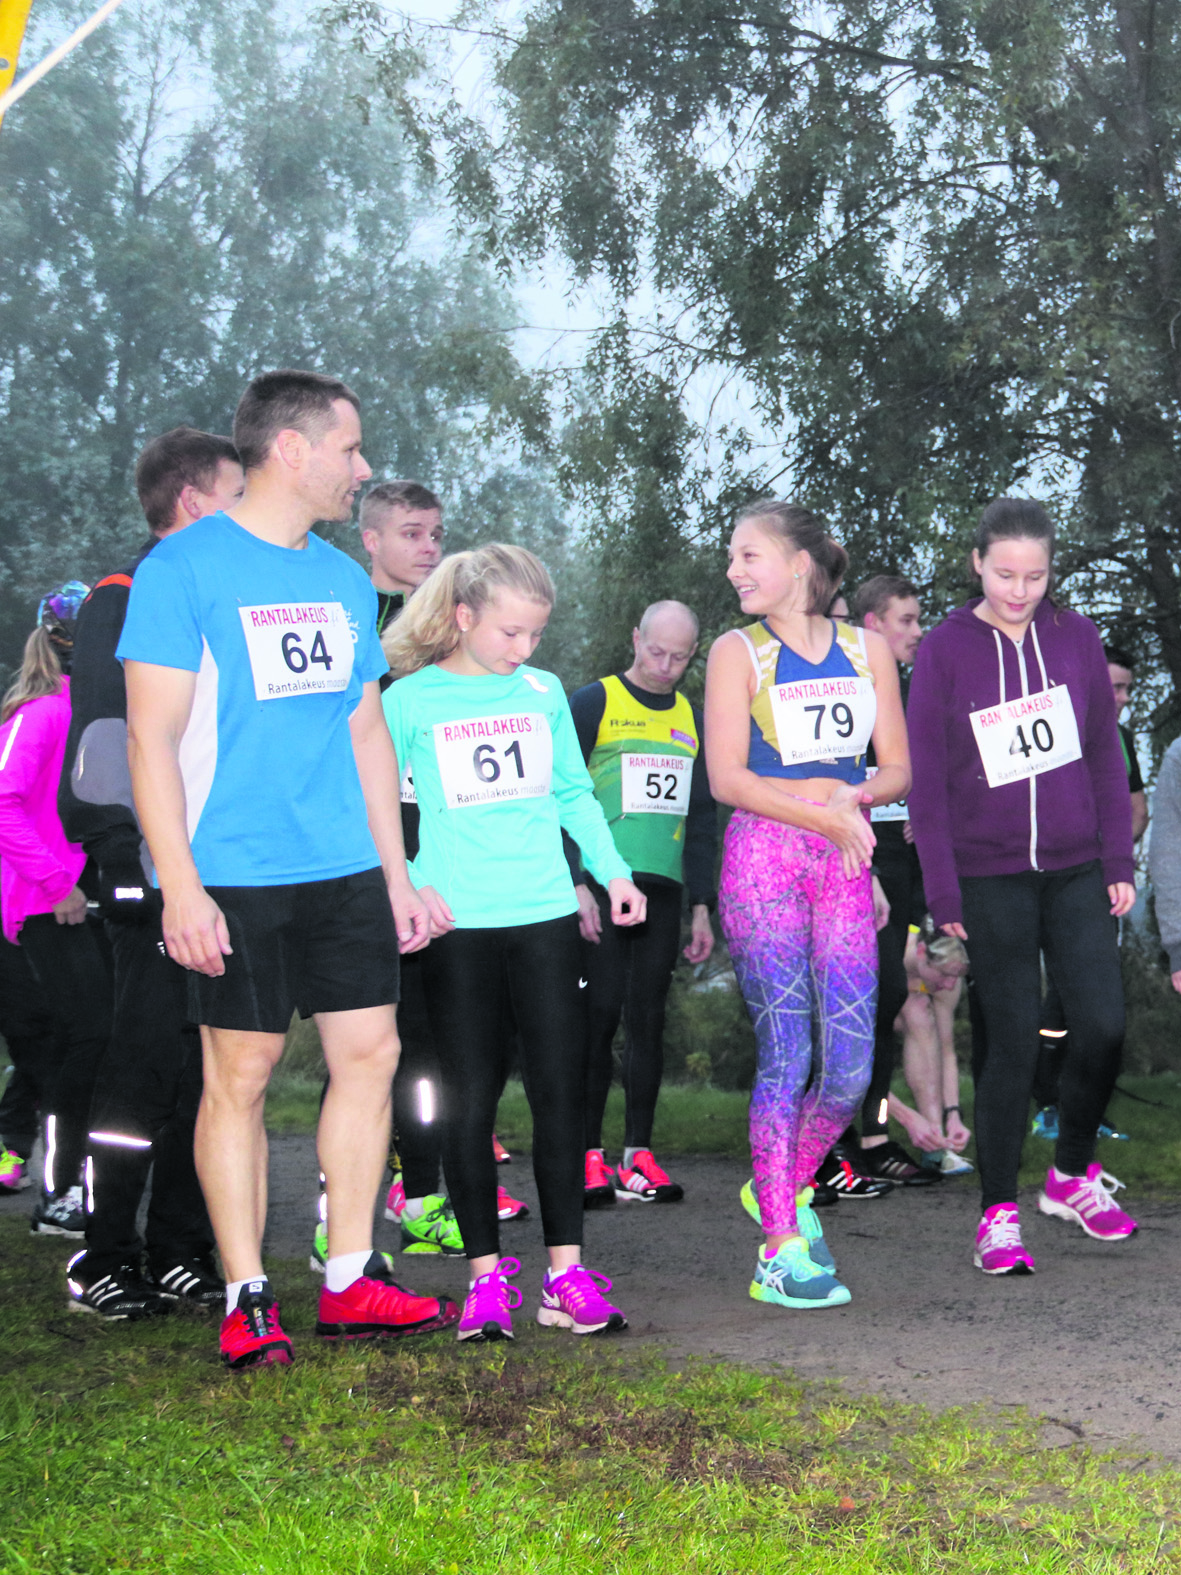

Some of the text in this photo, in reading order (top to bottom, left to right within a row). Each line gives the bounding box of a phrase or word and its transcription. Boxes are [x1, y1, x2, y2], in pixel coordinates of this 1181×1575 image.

[250, 607, 329, 627] RANTALAKEUS
[281, 630, 333, 674] 64
[268, 679, 326, 694] Rantalakeus
[779, 681, 857, 702] RANTALAKEUS
[804, 702, 854, 740] 79
[980, 694, 1054, 728] RANALAKEUS
[444, 717, 532, 742] RANTALAKEUS
[1009, 718, 1054, 758] 40
[473, 740, 525, 783] 61
[629, 757, 684, 770] RANTALAKEUS
[791, 744, 846, 760] Rantalakeus
[456, 786, 519, 804] Rantalakeus
[646, 773, 677, 801] 52
